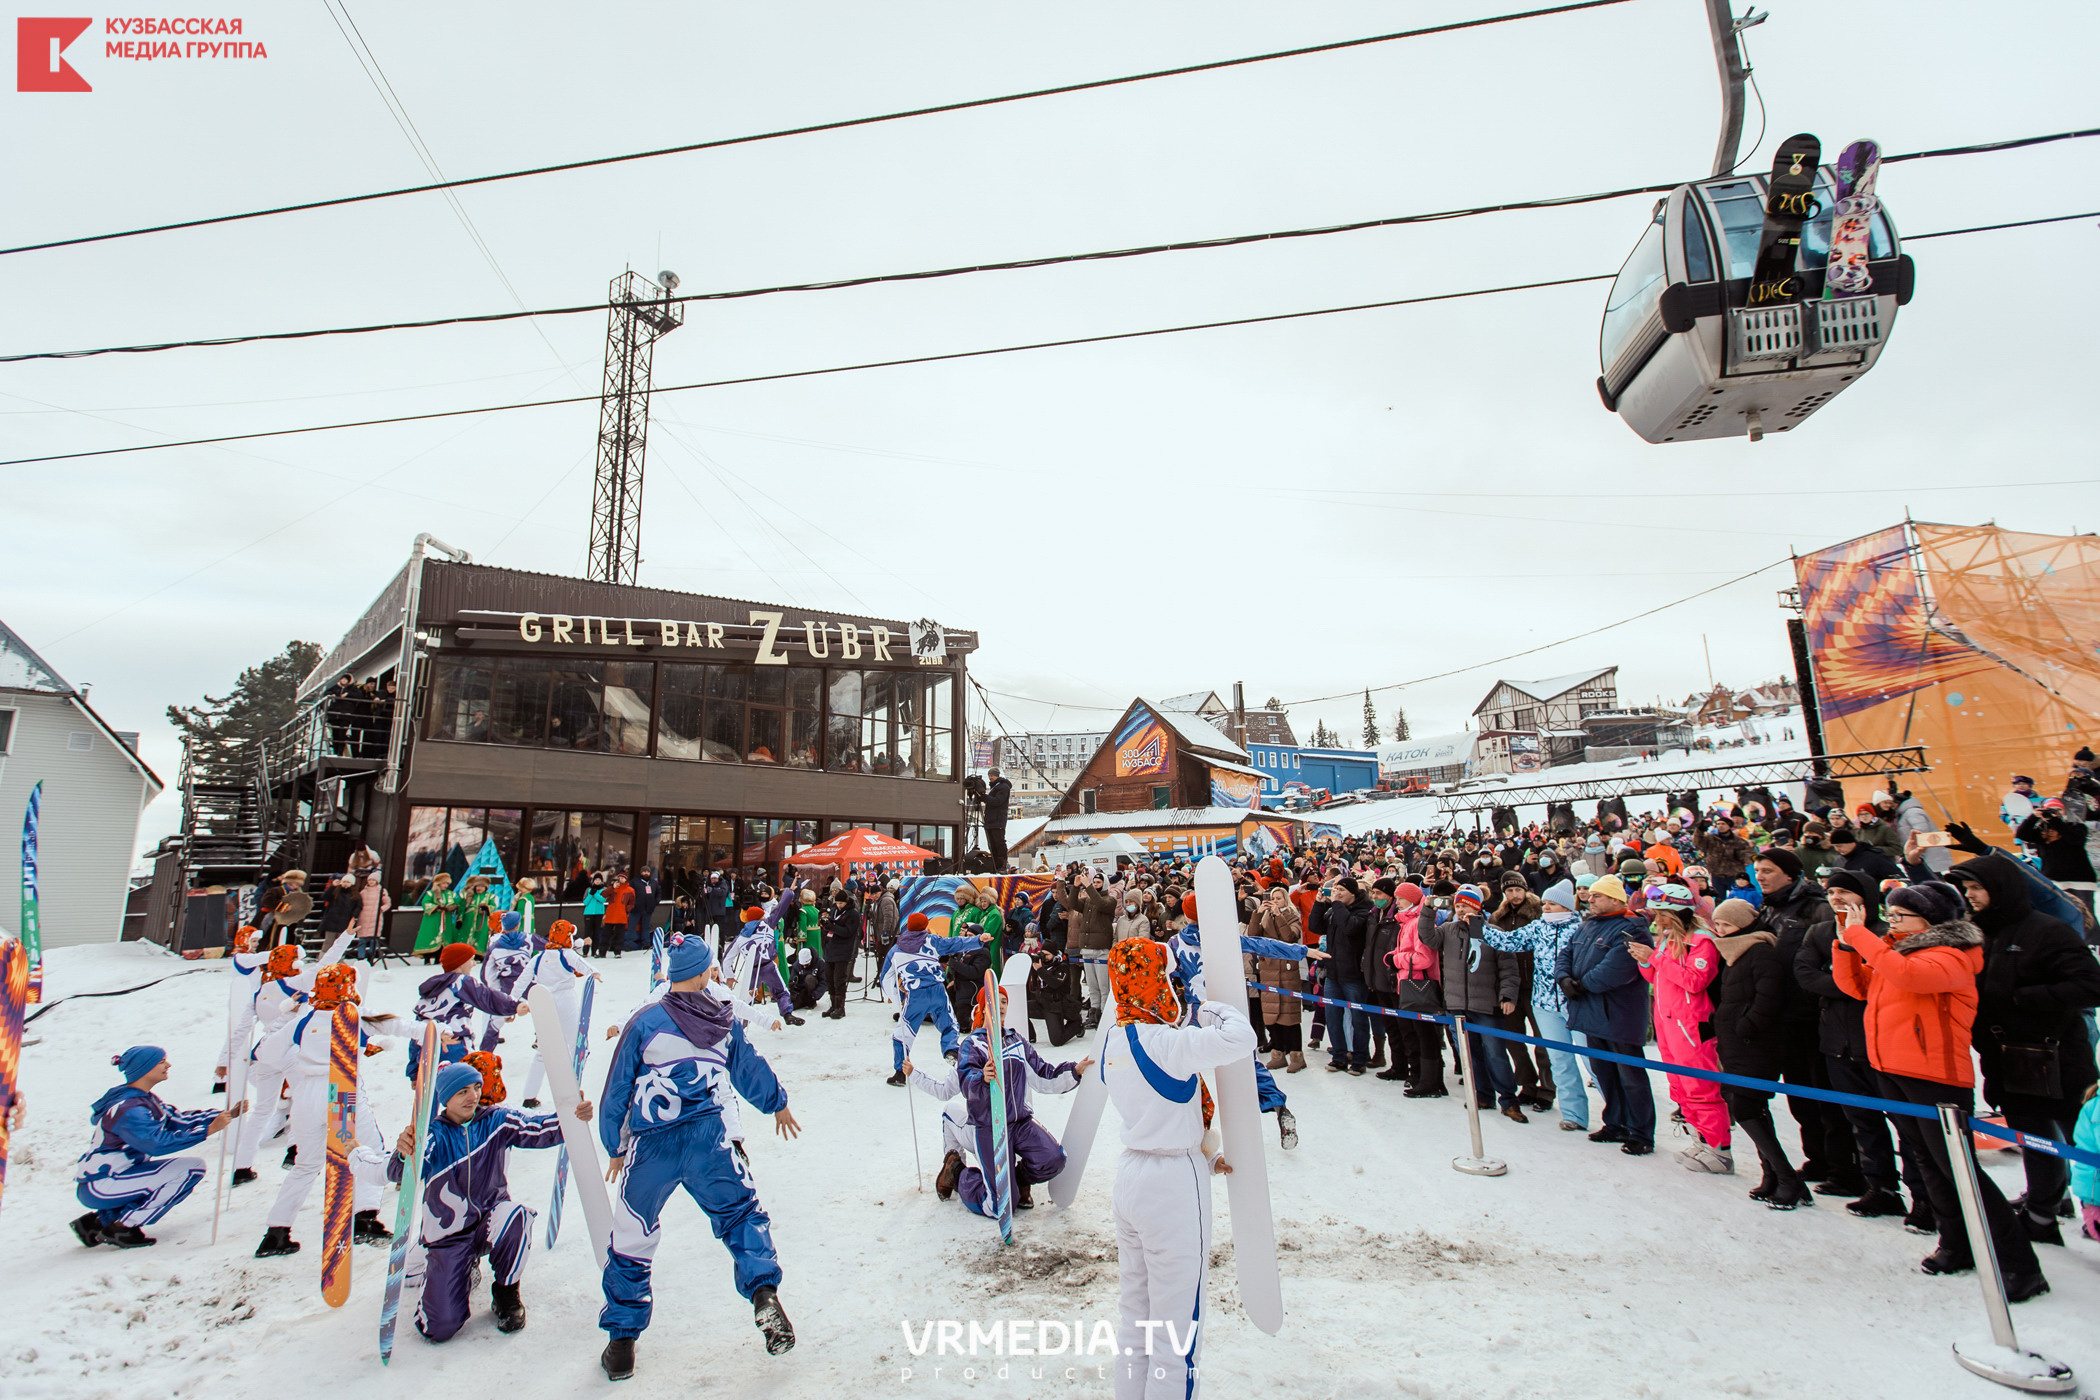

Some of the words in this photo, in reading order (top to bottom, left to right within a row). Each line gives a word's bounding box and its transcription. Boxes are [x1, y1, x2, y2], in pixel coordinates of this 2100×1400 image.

[520, 614, 645, 644] GRILL
[660, 621, 725, 649] BAR
[749, 610, 893, 665] ZUBR
[918, 656, 943, 666] ZUBR
[1122, 749, 1141, 759] 300
[1386, 747, 1431, 762] КАТОК
[1122, 756, 1162, 769] КУЗБАСС
